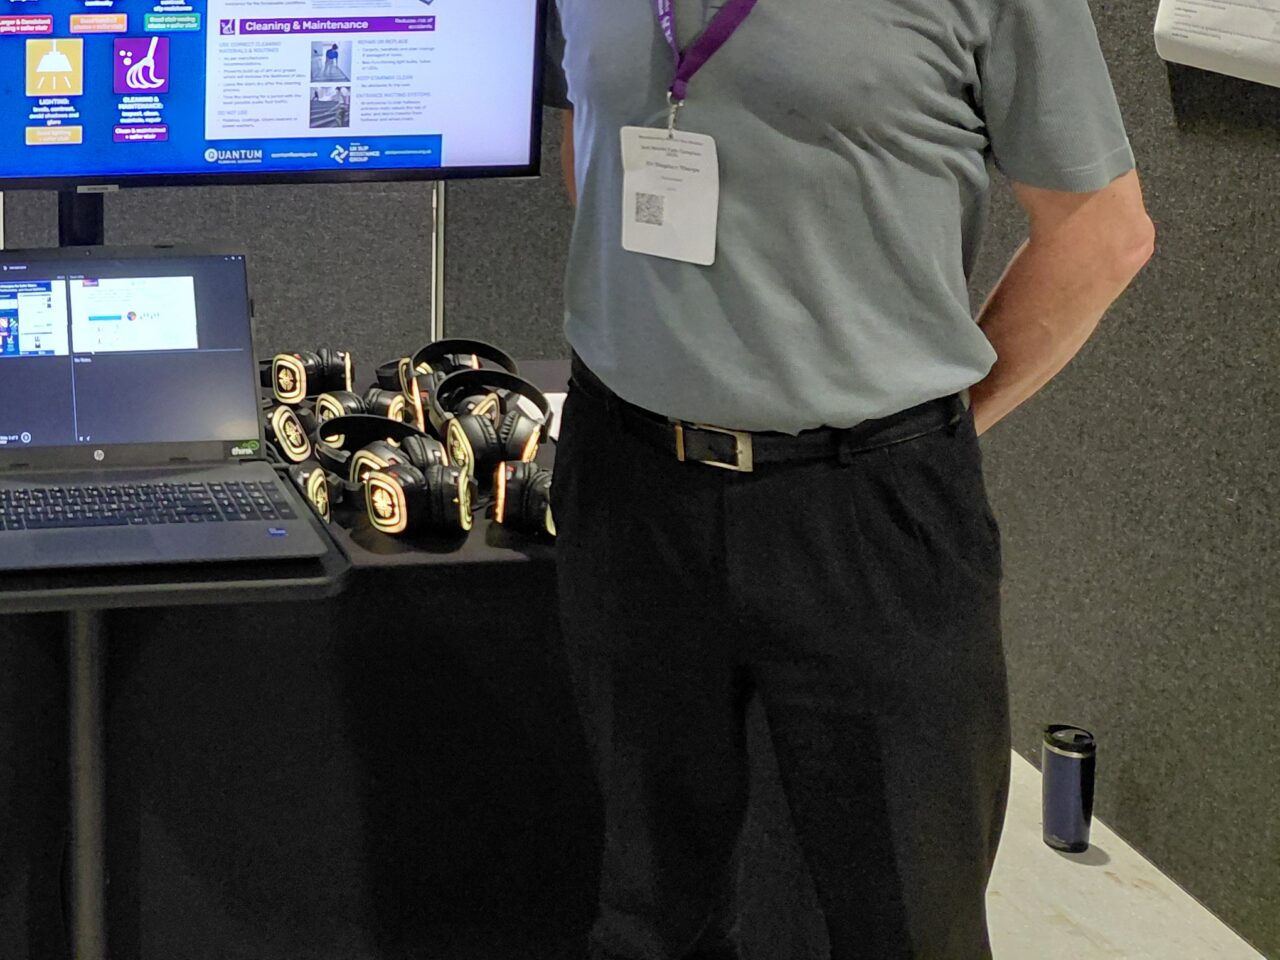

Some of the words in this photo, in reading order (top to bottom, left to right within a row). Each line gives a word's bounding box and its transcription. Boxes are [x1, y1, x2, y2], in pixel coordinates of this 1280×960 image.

[245, 21, 291, 32] Cleaning
[293, 21, 302, 30] &
[303, 20, 369, 31] Maintenance
[204, 146, 263, 163] QUANTUM
